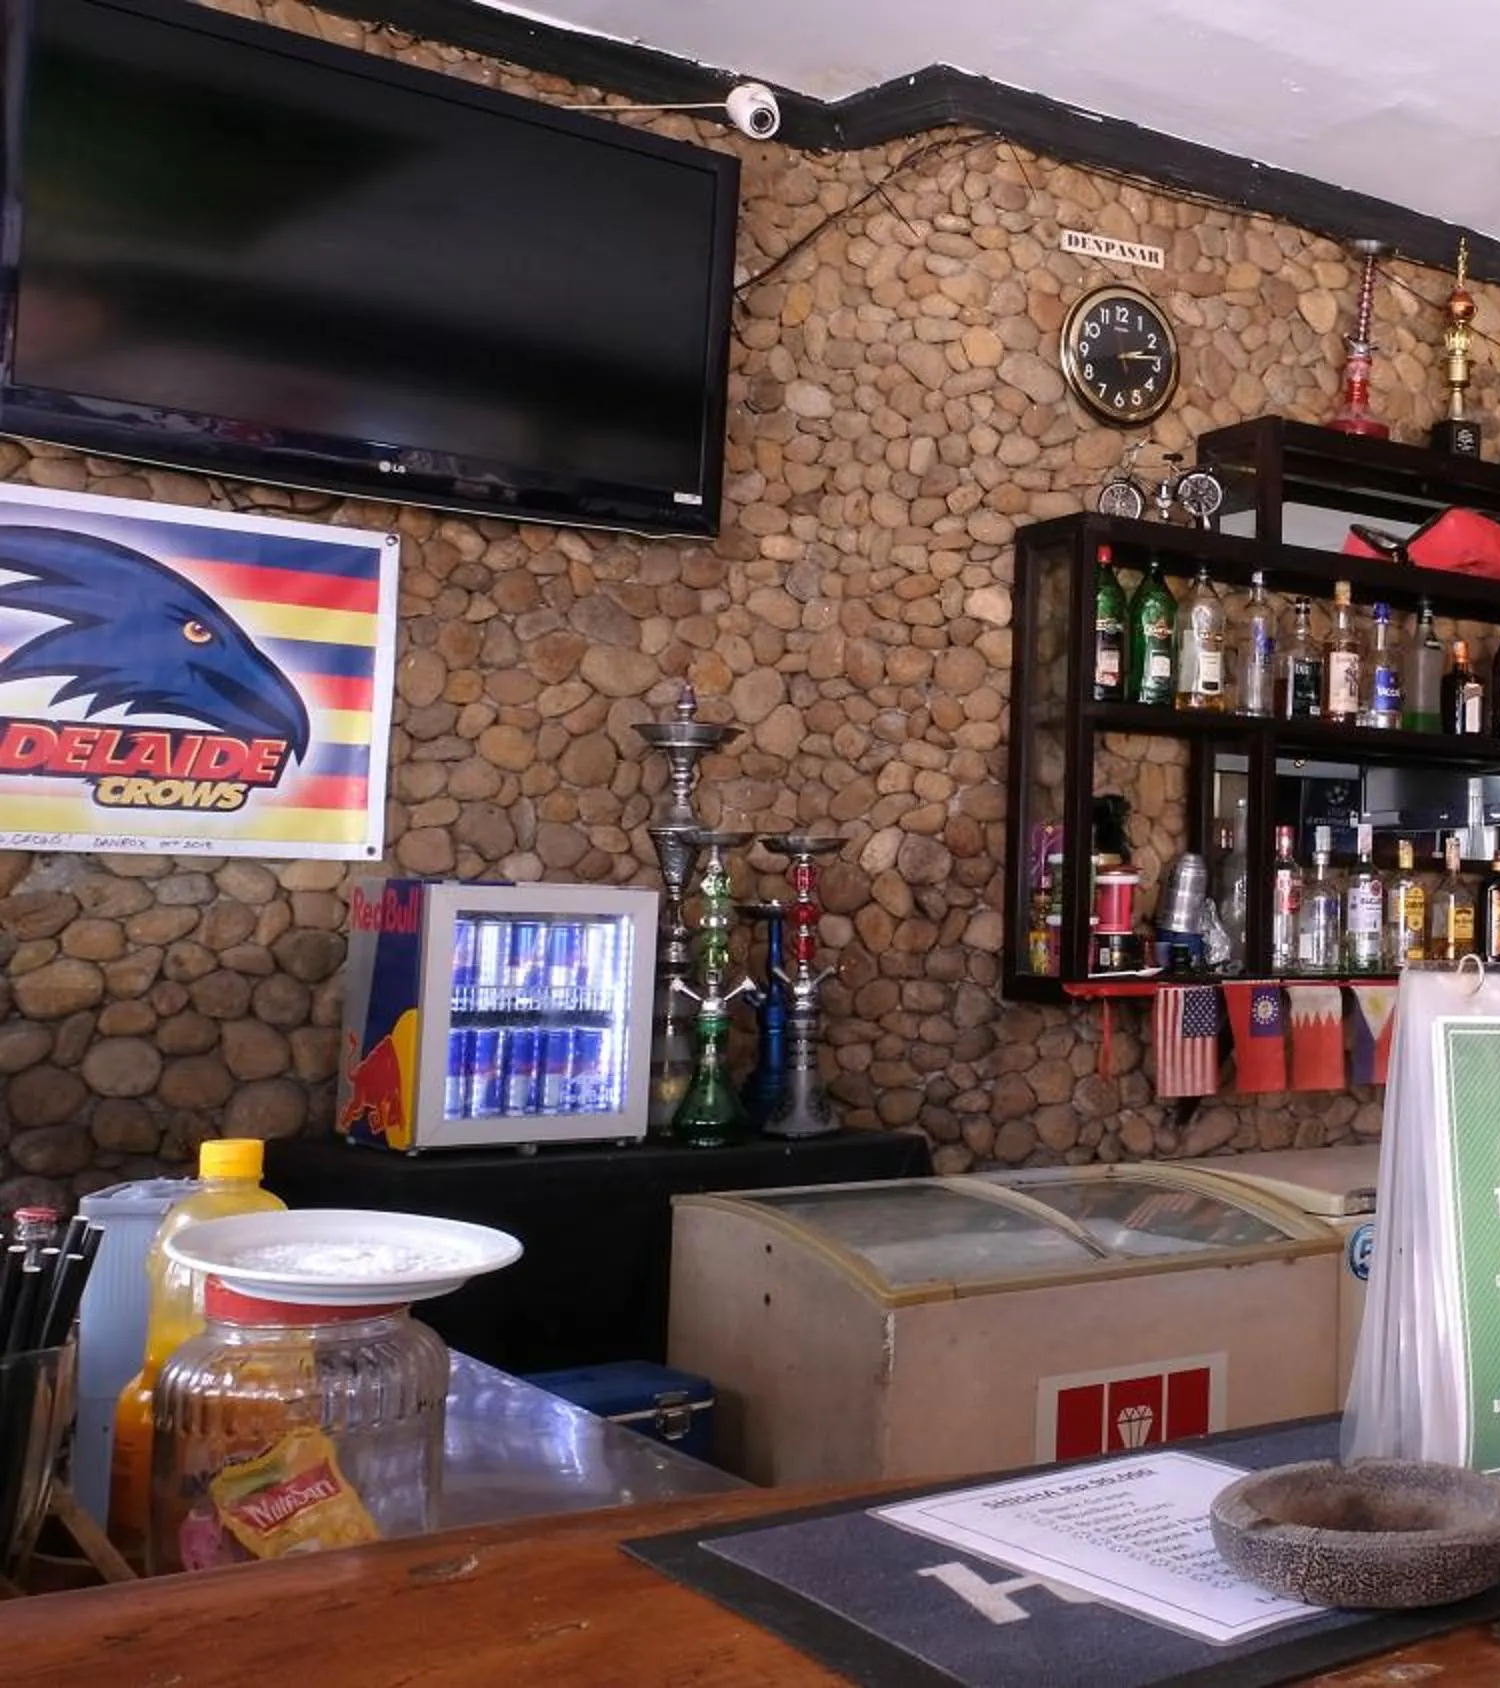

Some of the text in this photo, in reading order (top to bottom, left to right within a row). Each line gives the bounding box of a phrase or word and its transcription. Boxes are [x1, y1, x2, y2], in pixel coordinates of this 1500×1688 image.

[1067, 233, 1159, 264] DENPASAR
[1101, 308, 1110, 325] 11
[1115, 305, 1129, 323] 12
[1084, 321, 1101, 339] 10
[1137, 315, 1144, 332] 1
[1079, 341, 1089, 357] 9
[1147, 333, 1157, 349] 2
[1083, 363, 1094, 380] 8
[1151, 355, 1161, 373] 3
[1098, 383, 1107, 398] 7
[1144, 376, 1154, 392] 4
[1113, 392, 1125, 408] 6
[1131, 389, 1142, 406] 5
[0, 722, 287, 784] DELAIDE
[96, 776, 248, 809] CROWS
[353, 888, 419, 935] Red Bull
